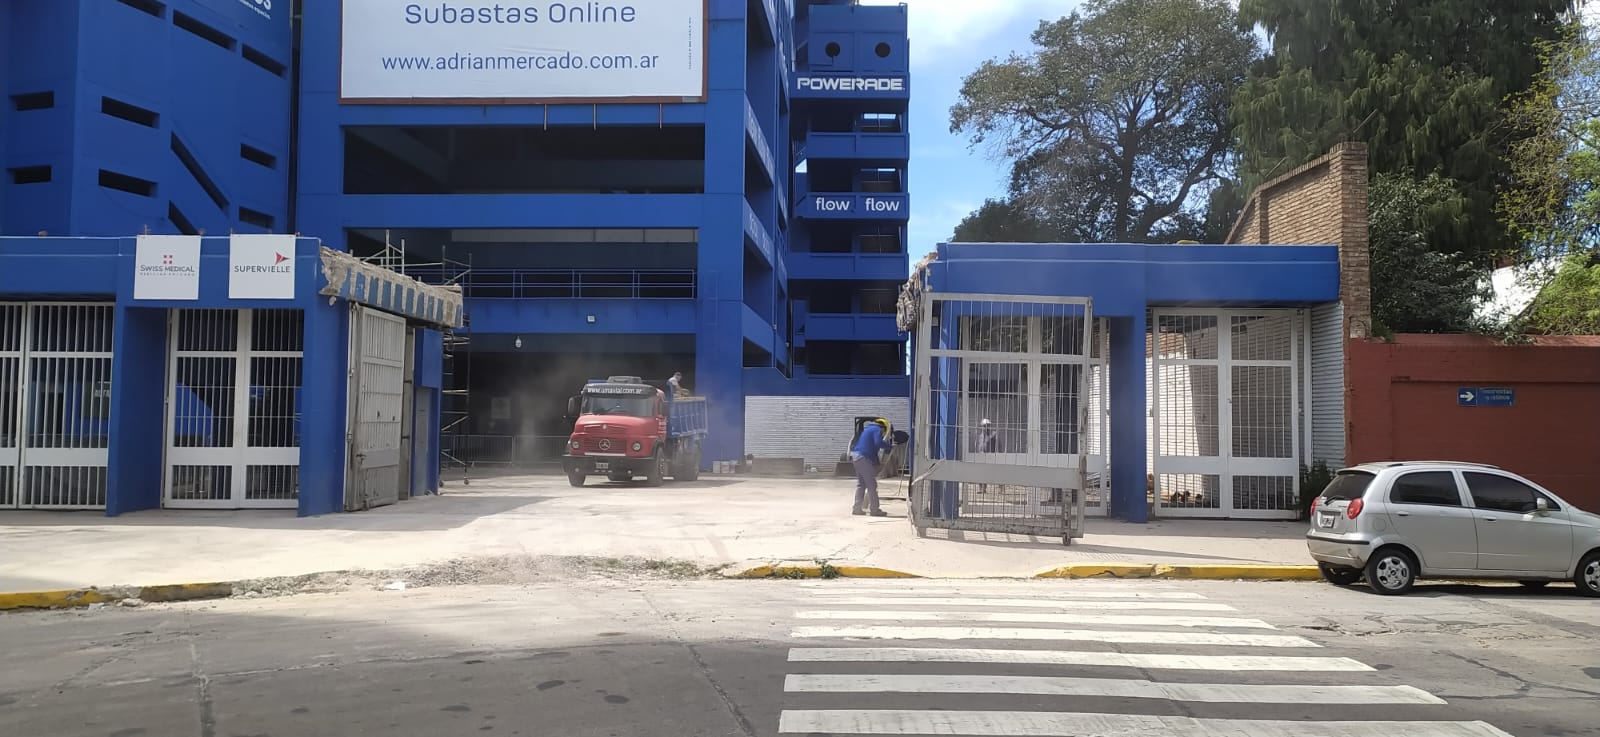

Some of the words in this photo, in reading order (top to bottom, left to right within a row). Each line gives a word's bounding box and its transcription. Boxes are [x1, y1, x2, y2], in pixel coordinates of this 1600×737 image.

[404, 3, 538, 24] Subastas
[548, 2, 636, 24] Online
[382, 52, 659, 71] www.adrianmercado.com.ar
[796, 77, 904, 91] POWERADE
[815, 197, 850, 211] flow
[865, 197, 900, 212] flow
[140, 264, 163, 272] SWISS
[234, 265, 291, 273] SUPERVIELLE
